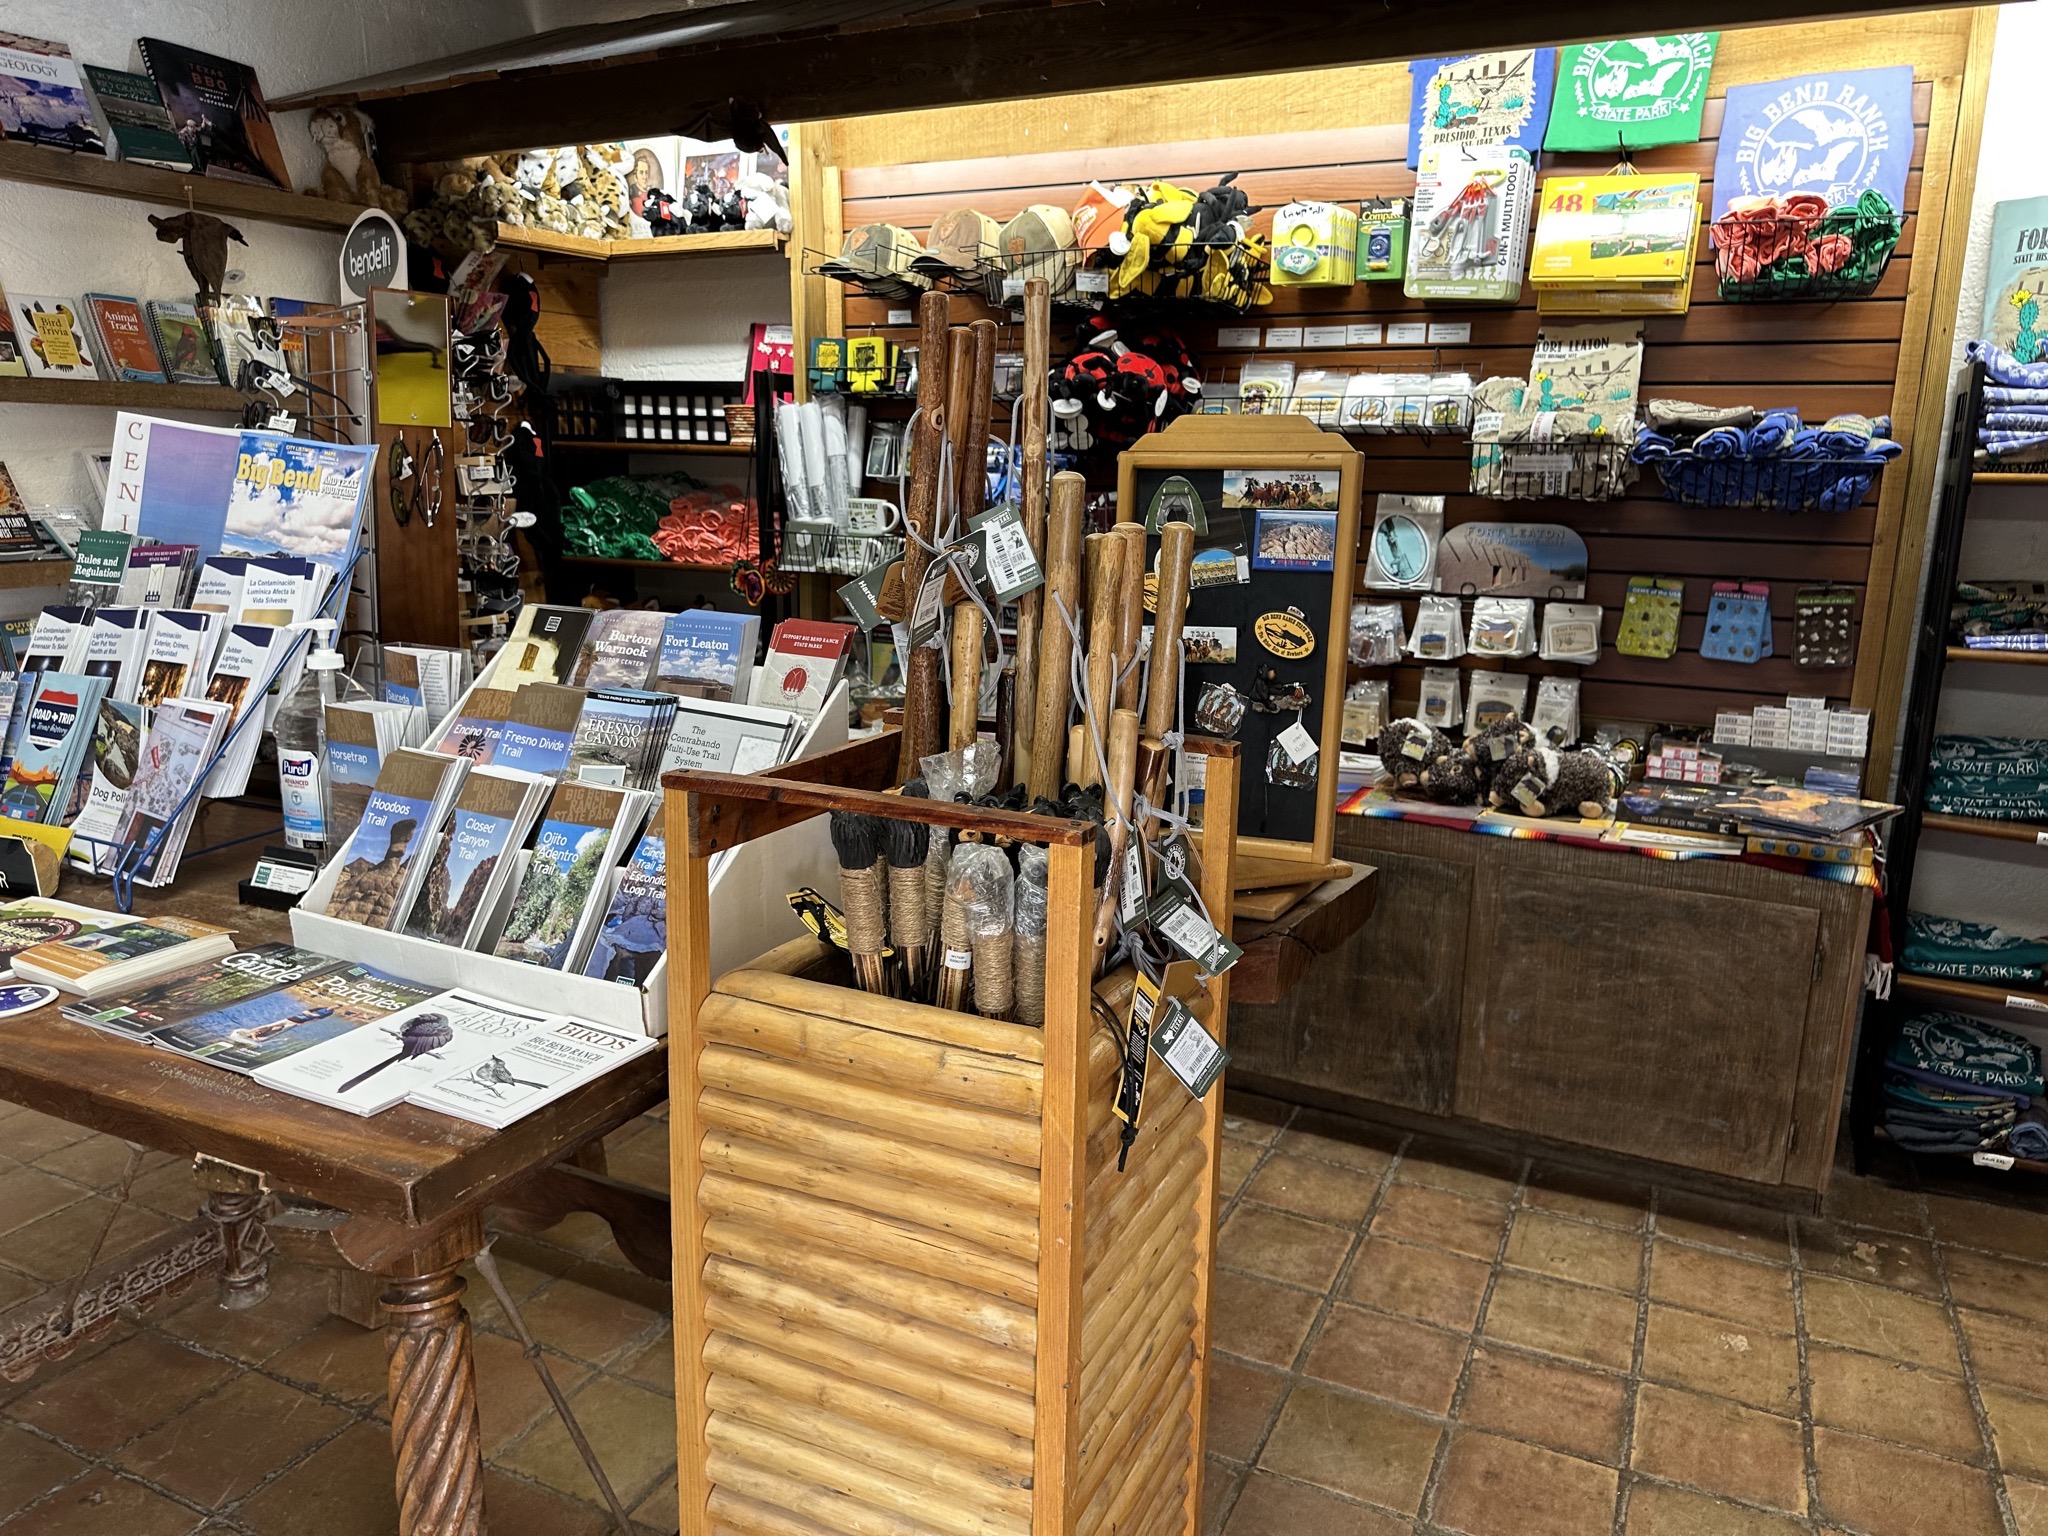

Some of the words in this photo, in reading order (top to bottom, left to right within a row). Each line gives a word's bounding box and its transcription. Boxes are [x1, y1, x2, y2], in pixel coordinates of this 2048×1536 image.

[0, 60, 58, 78] GEOLOGY
[189, 63, 225, 79] TEXAS
[191, 72, 229, 91] BBQ
[1594, 105, 1633, 121] STATE
[1635, 102, 1670, 119] PARK
[1736, 124, 1765, 164] BIG
[1763, 81, 1829, 120] BEND
[1838, 84, 1889, 153] RANCH
[1501, 162, 1519, 233] MULTI-TOOLS
[1548, 194, 1583, 213] 48
[350, 236, 391, 277] bendetti
[1497, 235, 1509, 266] 6-IN-1
[157, 303, 178, 313] Birds
[41, 317, 62, 328] Bird
[104, 310, 138, 324] Animal
[39, 324, 69, 337] Trivia
[108, 320, 139, 332] Tracks
[237, 453, 270, 492] Big
[269, 458, 323, 492] Bend
[321, 485, 358, 498] MOUNTAINS
[337, 478, 359, 490] TEXAS
[1510, 527, 1565, 539] LEATON
[76, 553, 101, 564] Rules
[103, 556, 119, 566] and
[1271, 552, 1299, 560] BEND
[1300, 552, 1330, 561] RANCH
[74, 564, 121, 579] Regulations
[257, 579, 295, 587] Contaminación
[1714, 591, 1741, 600] AWESOME
[609, 629, 652, 646] Barton
[665, 634, 689, 648] Fort
[691, 636, 729, 651] Leaton
[782, 633, 802, 641] SUPPORT
[822, 637, 839, 645] RANCH
[155, 649, 178, 658] Seguridad
[595, 640, 649, 658] Warnock
[227, 663, 241, 671] Safety
[597, 656, 619, 665] VISITOR
[621, 658, 645, 667] CENTER
[1, 671, 15, 680] MAP
[32, 708, 50, 721] ROAD
[58, 712, 75, 725] TRIP
[453, 724, 483, 737] Encino
[484, 727, 502, 739] Trai
[587, 718, 642, 738] FRESNO
[692, 725, 707, 735] The
[505, 730, 538, 747] Fresno
[539, 737, 565, 752] Divide
[584, 730, 639, 748] CANYON
[670, 732, 721, 749] Contrabando
[330, 747, 368, 765] Horsetrap
[501, 744, 524, 758] Trail
[665, 743, 700, 757] Multi-Use
[702, 749, 721, 761] Trail
[283, 760, 309, 776] Purell
[332, 762, 348, 774] Trail
[674, 756, 703, 769] System
[1950, 760, 1993, 773] STATE
[1998, 759, 2036, 775] PARK
[284, 779, 309, 787] ADVANCED
[477, 790, 509, 802] RANCH
[565, 788, 586, 801] BIG
[371, 796, 411, 815] Hoodoos
[463, 800, 490, 812] STATE
[569, 799, 606, 813] RANCH
[367, 811, 388, 827] Trail
[554, 810, 585, 822] STATE
[465, 817, 496, 834] Closed
[457, 831, 490, 849] Canyon
[543, 831, 568, 847] Ojito
[458, 846, 478, 861] Trail
[537, 846, 579, 863] Adentro
[641, 846, 665, 859] Cinco
[532, 860, 556, 875] Trail
[221, 952, 304, 984] Guide
[1926, 960, 1968, 976] STATE
[1972, 963, 2012, 979] PARK
[315, 975, 407, 1011] Parques
[363, 974, 385, 984] TEXAS
[386, 980, 408, 990] STATE
[409, 987, 433, 996] PARKS
[454, 1016, 522, 1039] BIRDS
[473, 1011, 537, 1032] TEXAS
[553, 1023, 632, 1050] BIRDS
[520, 1042, 539, 1051] STATE
[536, 1044, 554, 1054] PARK
[553, 1049, 567, 1058] AND
[566, 1055, 593, 1066] VICINITY
[528, 1036, 548, 1047] BIG
[545, 1039, 573, 1054] BEND
[569, 1048, 604, 1062] RANCH
[1939, 1064, 1982, 1080] STATE
[1986, 1071, 2025, 1086] PARK
